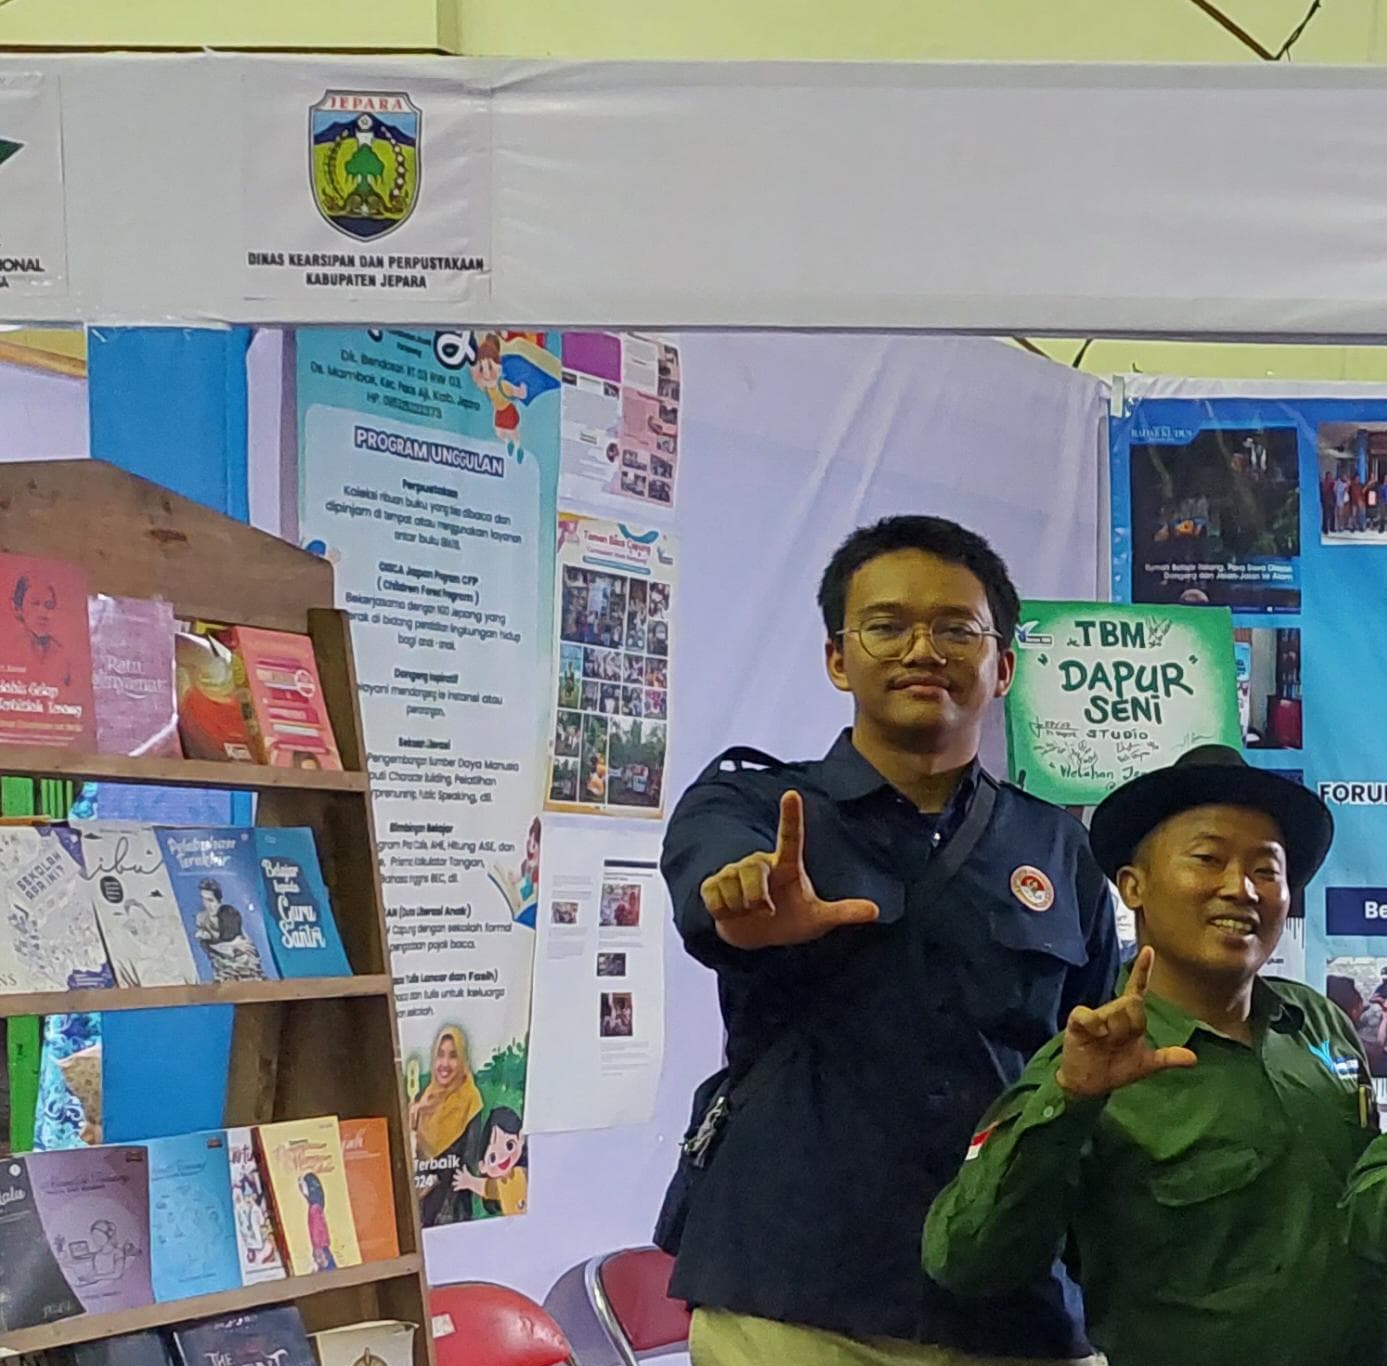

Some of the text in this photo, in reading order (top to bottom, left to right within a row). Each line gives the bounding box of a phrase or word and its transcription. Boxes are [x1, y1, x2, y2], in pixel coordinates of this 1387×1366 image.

[329, 96, 403, 112] JEPARA
[248, 252, 484, 272] DINAS KEARSIPAN DAN PERPUSTAKAAN
[305, 273, 427, 289] KABUPATEN JEPARA
[356, 427, 504, 476] PROGRAM UNGGULAN
[1074, 621, 1146, 648] TBM
[261, 858, 299, 883] Belajar
[278, 896, 316, 923] Guru
[279, 921, 326, 948] Santri
